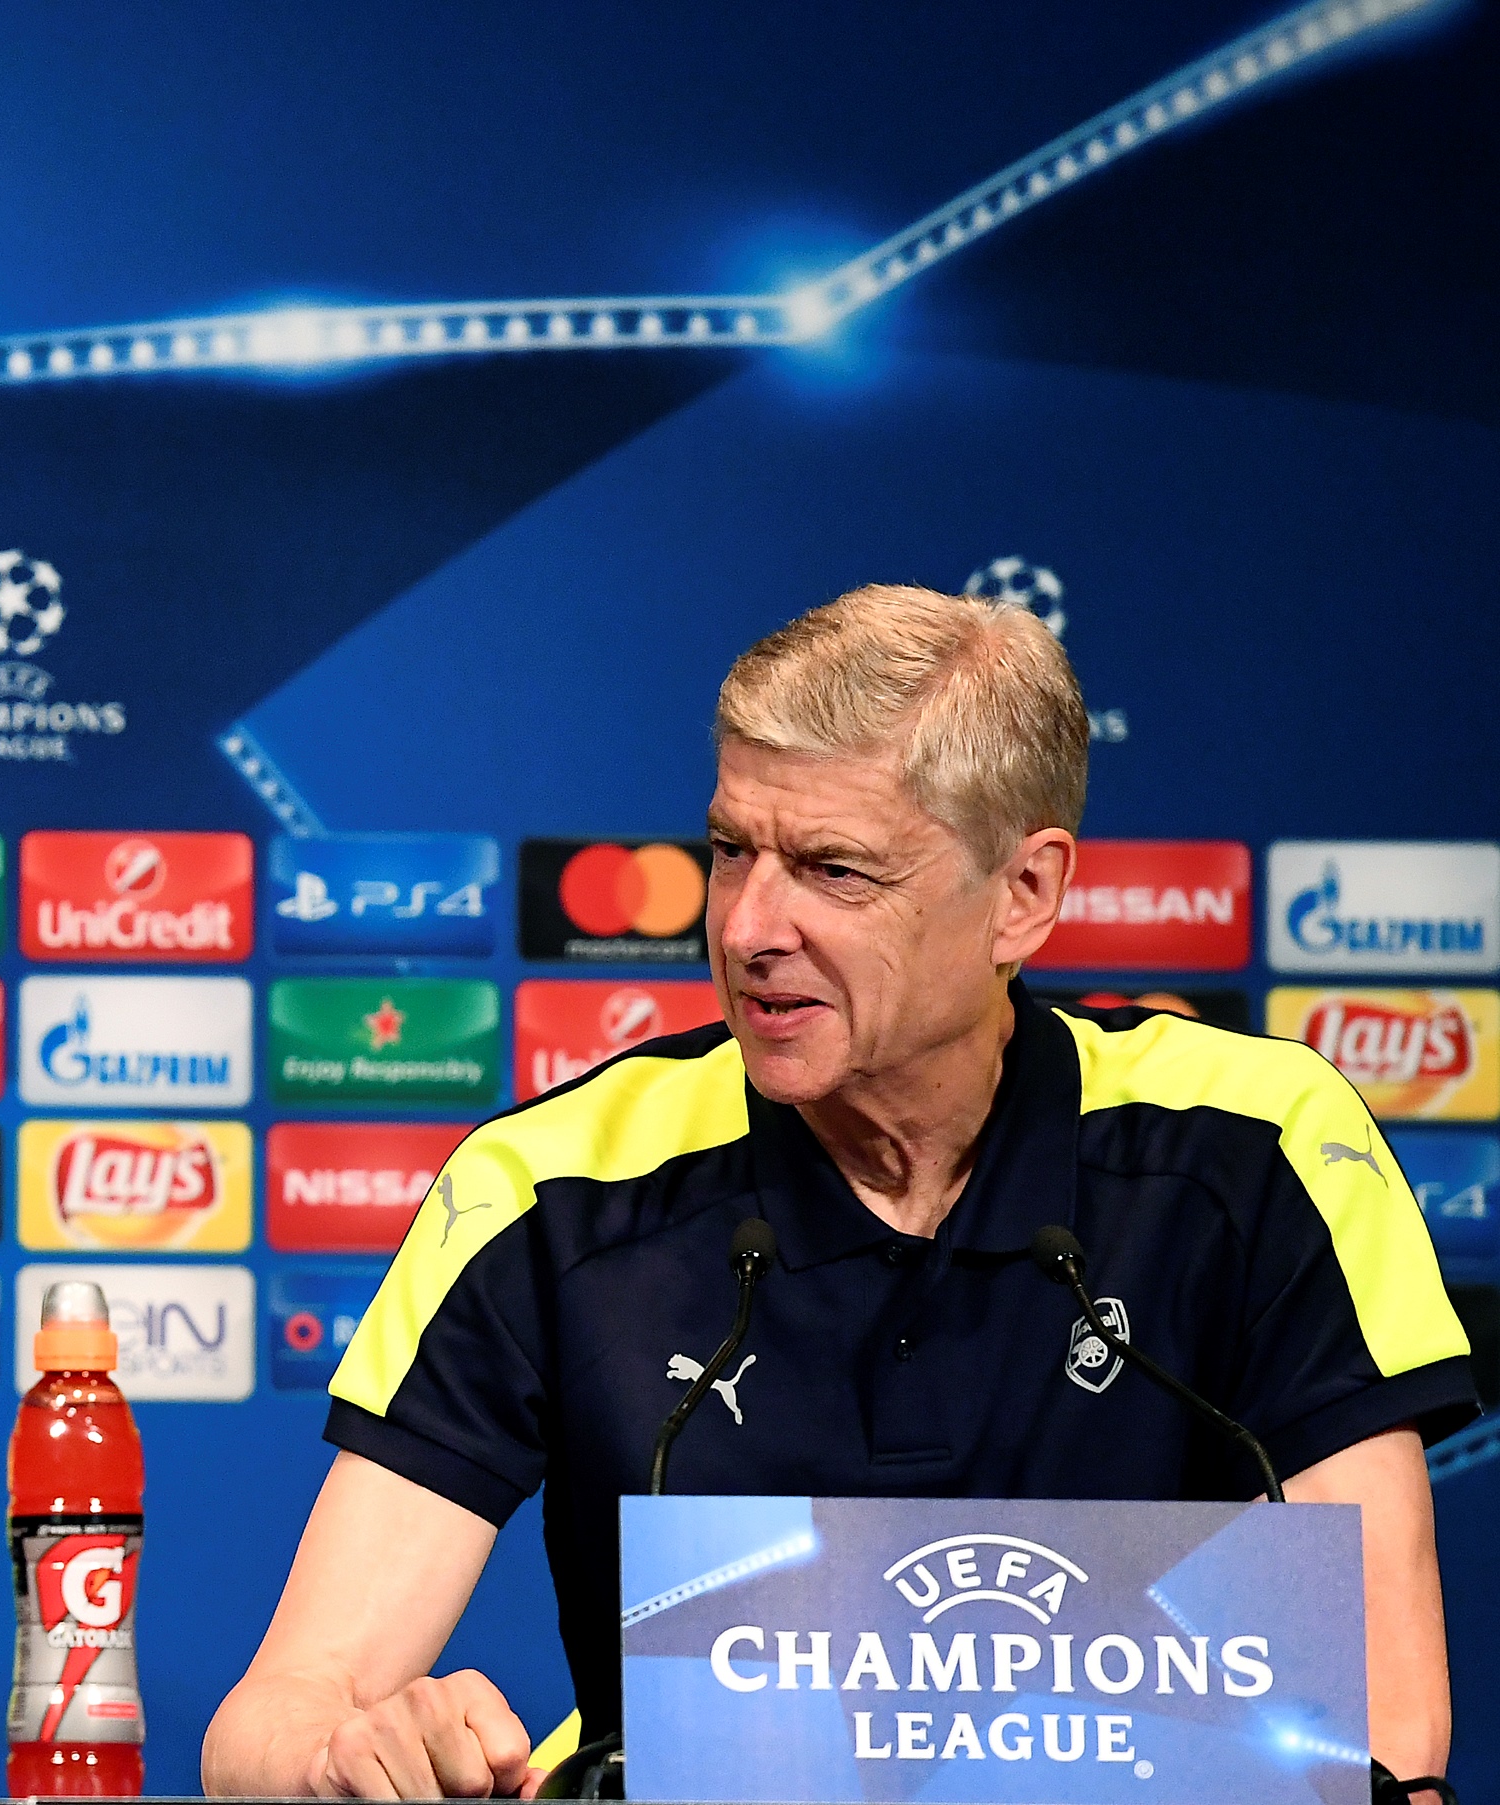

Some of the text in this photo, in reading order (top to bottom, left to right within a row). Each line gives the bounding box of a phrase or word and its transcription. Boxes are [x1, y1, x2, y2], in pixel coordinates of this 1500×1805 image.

[351, 880, 486, 918] PS4
[1059, 886, 1234, 925] ISSAN
[38, 900, 233, 950] UniCredit
[283, 1168, 435, 1207] NISSA
[61, 1545, 125, 1628] G
[895, 1547, 1070, 1614] UEFA
[709, 1625, 1276, 1698] CHAMPIONS
[853, 1711, 1137, 1763] LEAGUE
